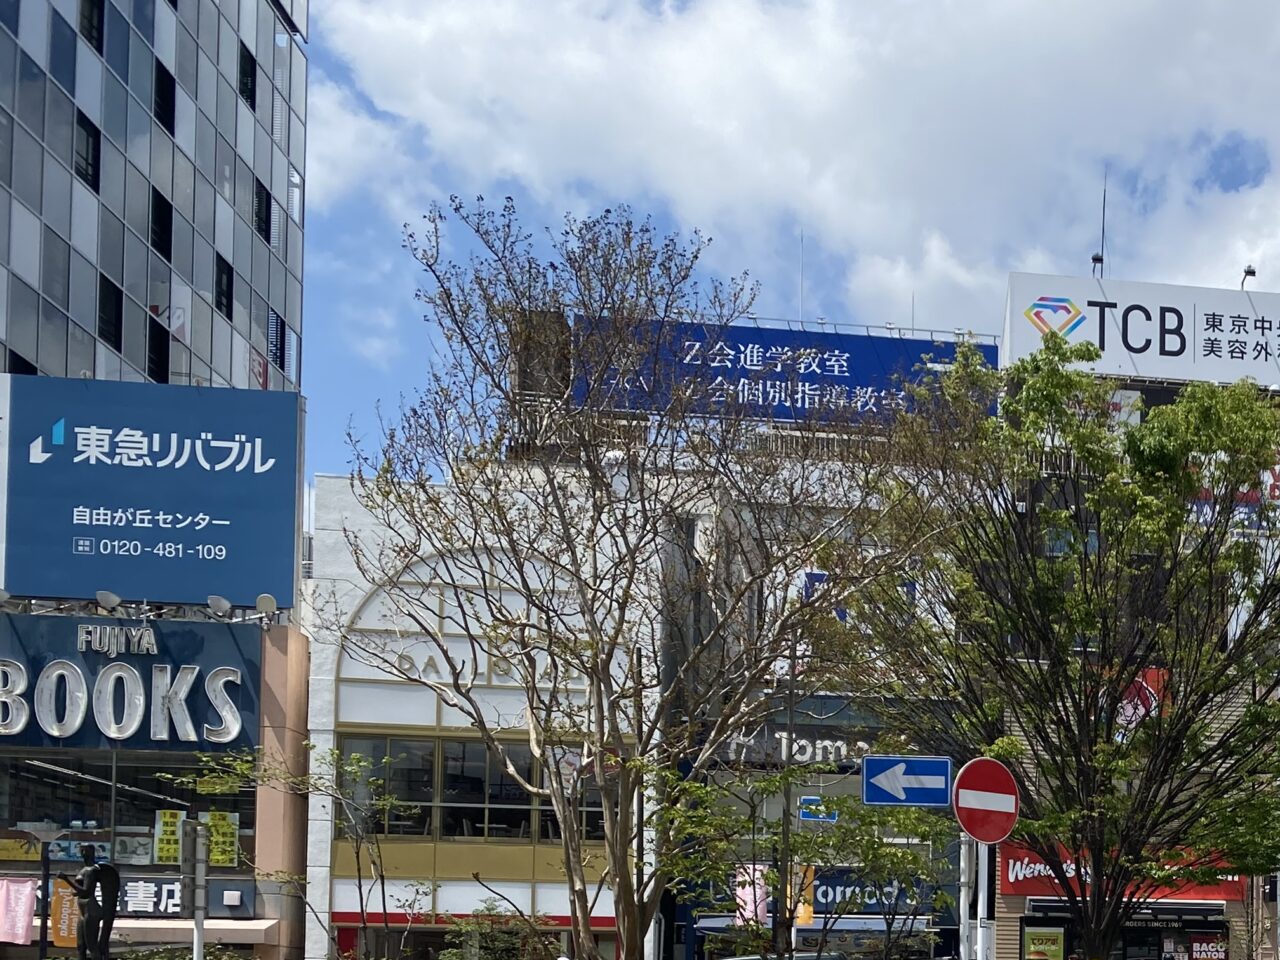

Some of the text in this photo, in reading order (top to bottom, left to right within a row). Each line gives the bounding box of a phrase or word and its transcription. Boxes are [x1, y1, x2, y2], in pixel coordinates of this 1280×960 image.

[1086, 300, 1187, 357] TCB
[682, 341, 851, 377] Z会進学教室
[73, 425, 276, 474] 東急リバブル
[72, 505, 231, 530] 自由が丘センター
[99, 539, 226, 560] 0120-481-109
[77, 624, 159, 658] FUJIYA
[0, 658, 242, 743] BOOKS
[1192, 951, 1226, 960] NATOR
